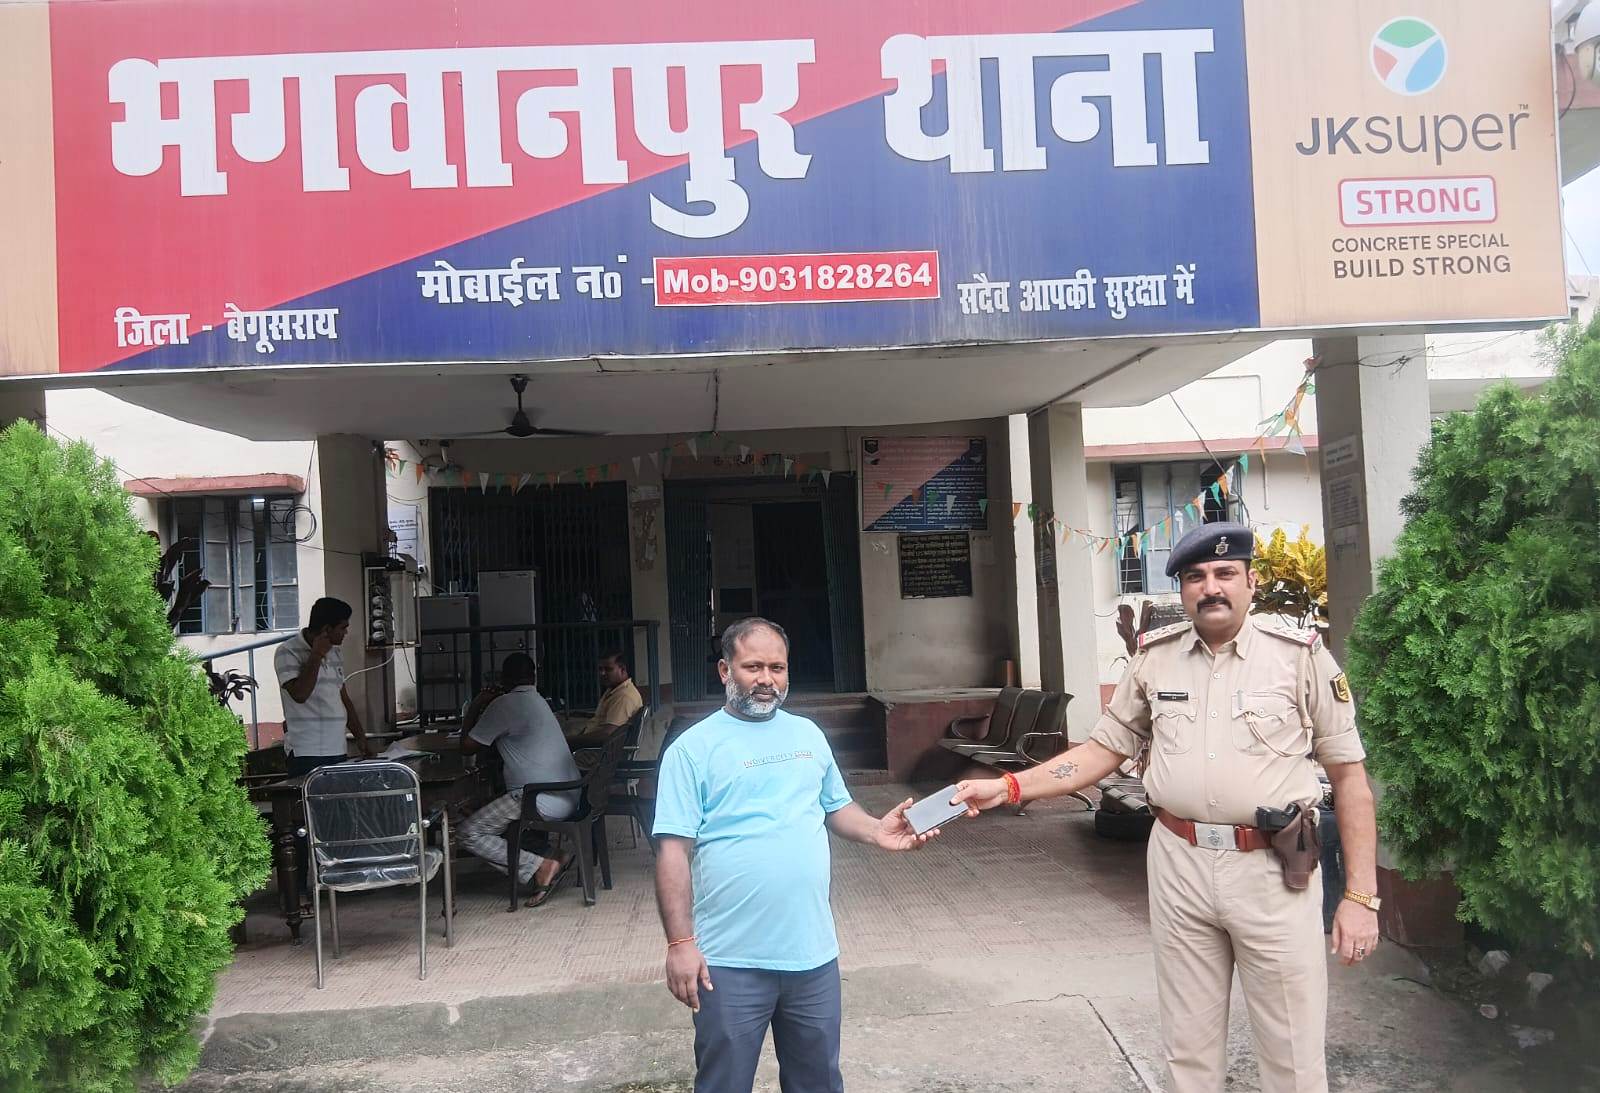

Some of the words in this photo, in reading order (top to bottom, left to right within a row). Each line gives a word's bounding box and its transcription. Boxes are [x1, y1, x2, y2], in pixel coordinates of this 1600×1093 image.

[107, 38, 816, 238] भगवानपुर
[881, 28, 1214, 173] थाना
[1356, 186, 1481, 216] STRONG
[1332, 235, 1431, 253] CONCRETE
[1436, 233, 1510, 249] SPECIAL
[416, 257, 561, 307] मोबाईल
[663, 262, 933, 294] Mob-9031828264
[1333, 258, 1405, 279] BUILD
[1412, 255, 1511, 276] STRONG
[957, 272, 1010, 315] सदैव
[1019, 268, 1097, 312] आपकी
[1103, 274, 1167, 320] सुरक्षा
[1173, 263, 1196, 305] में
[114, 307, 191, 347] जिला
[223, 303, 339, 354] बेगूसराय
